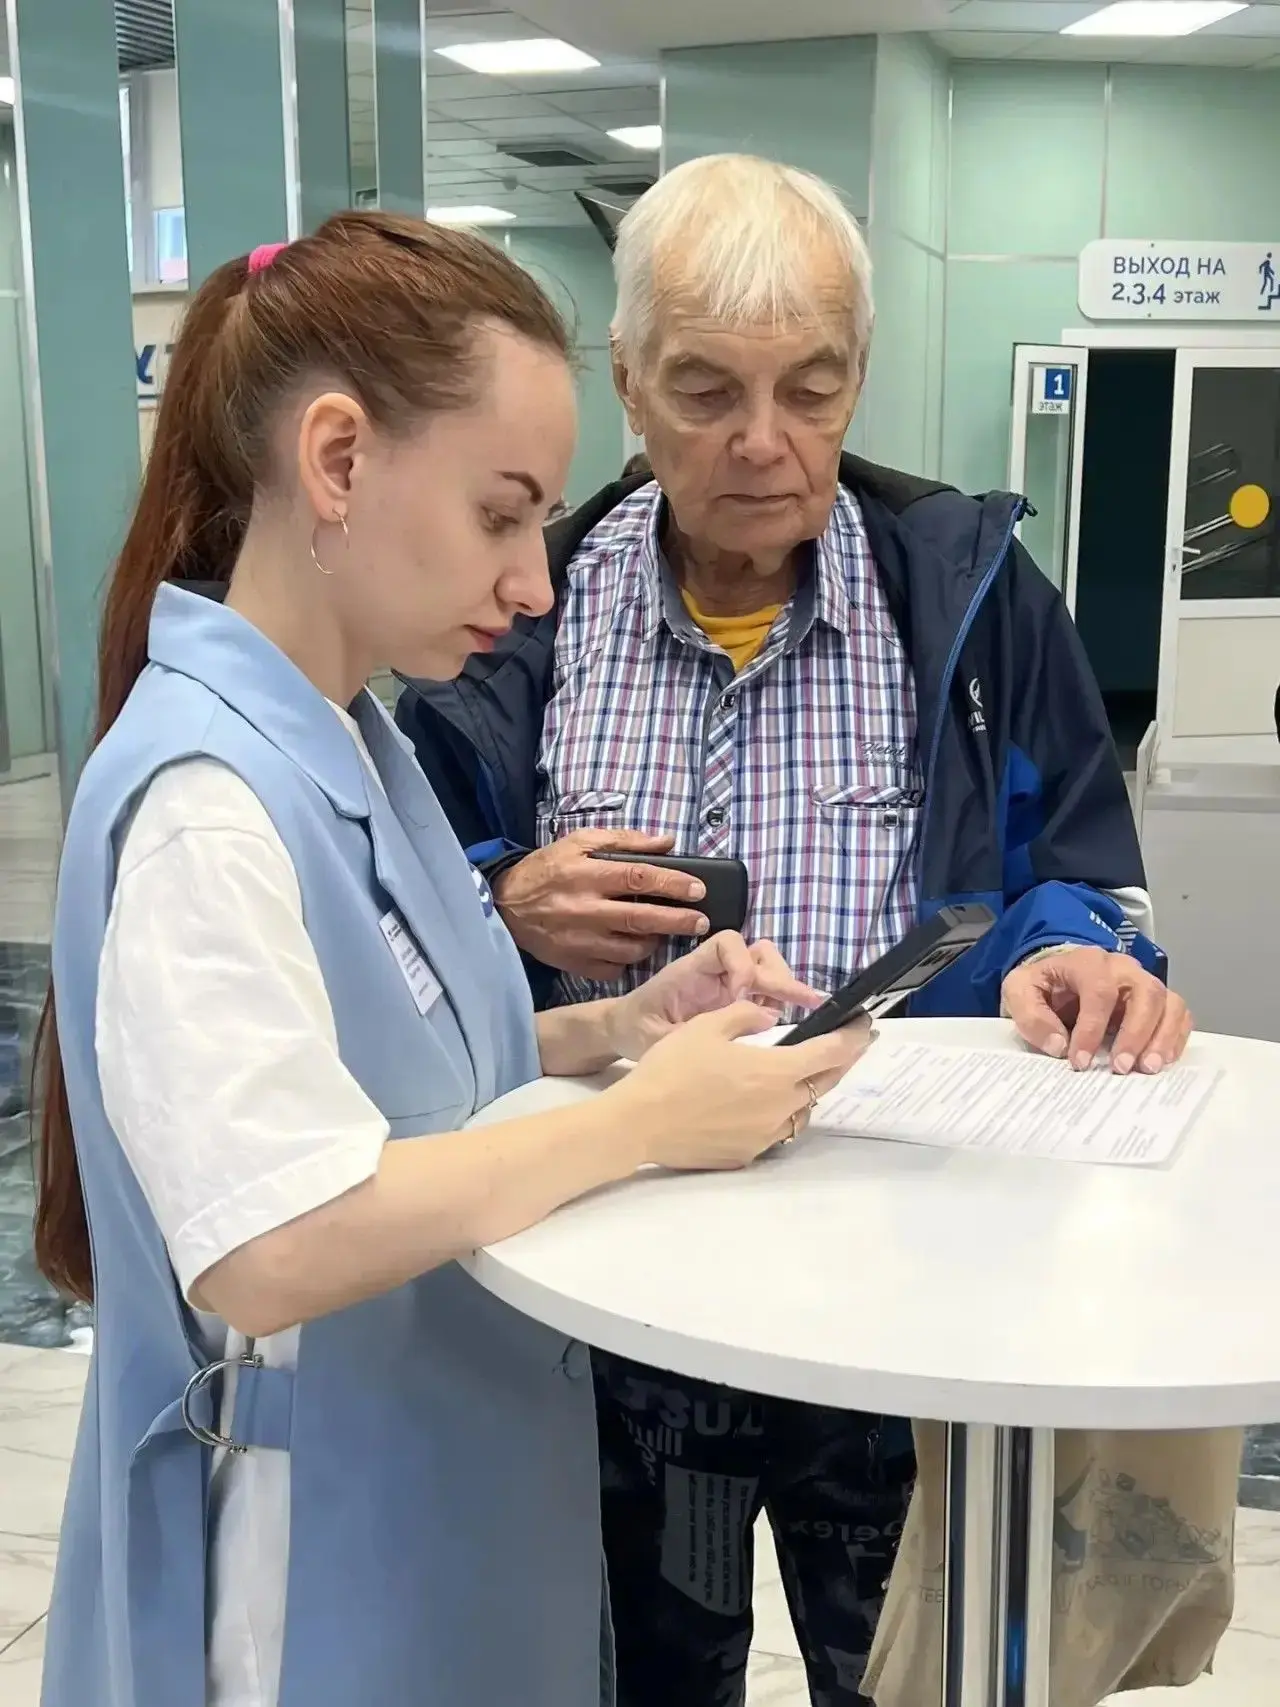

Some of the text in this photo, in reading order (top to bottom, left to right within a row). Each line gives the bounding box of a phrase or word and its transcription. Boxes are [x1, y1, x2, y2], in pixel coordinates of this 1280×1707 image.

[1113, 256, 1226, 279] ВЫХОД НА
[1111, 282, 1221, 305] 2,3,4 этаж
[1053, 373, 1065, 396] 1
[1039, 401, 1063, 413] этаж
